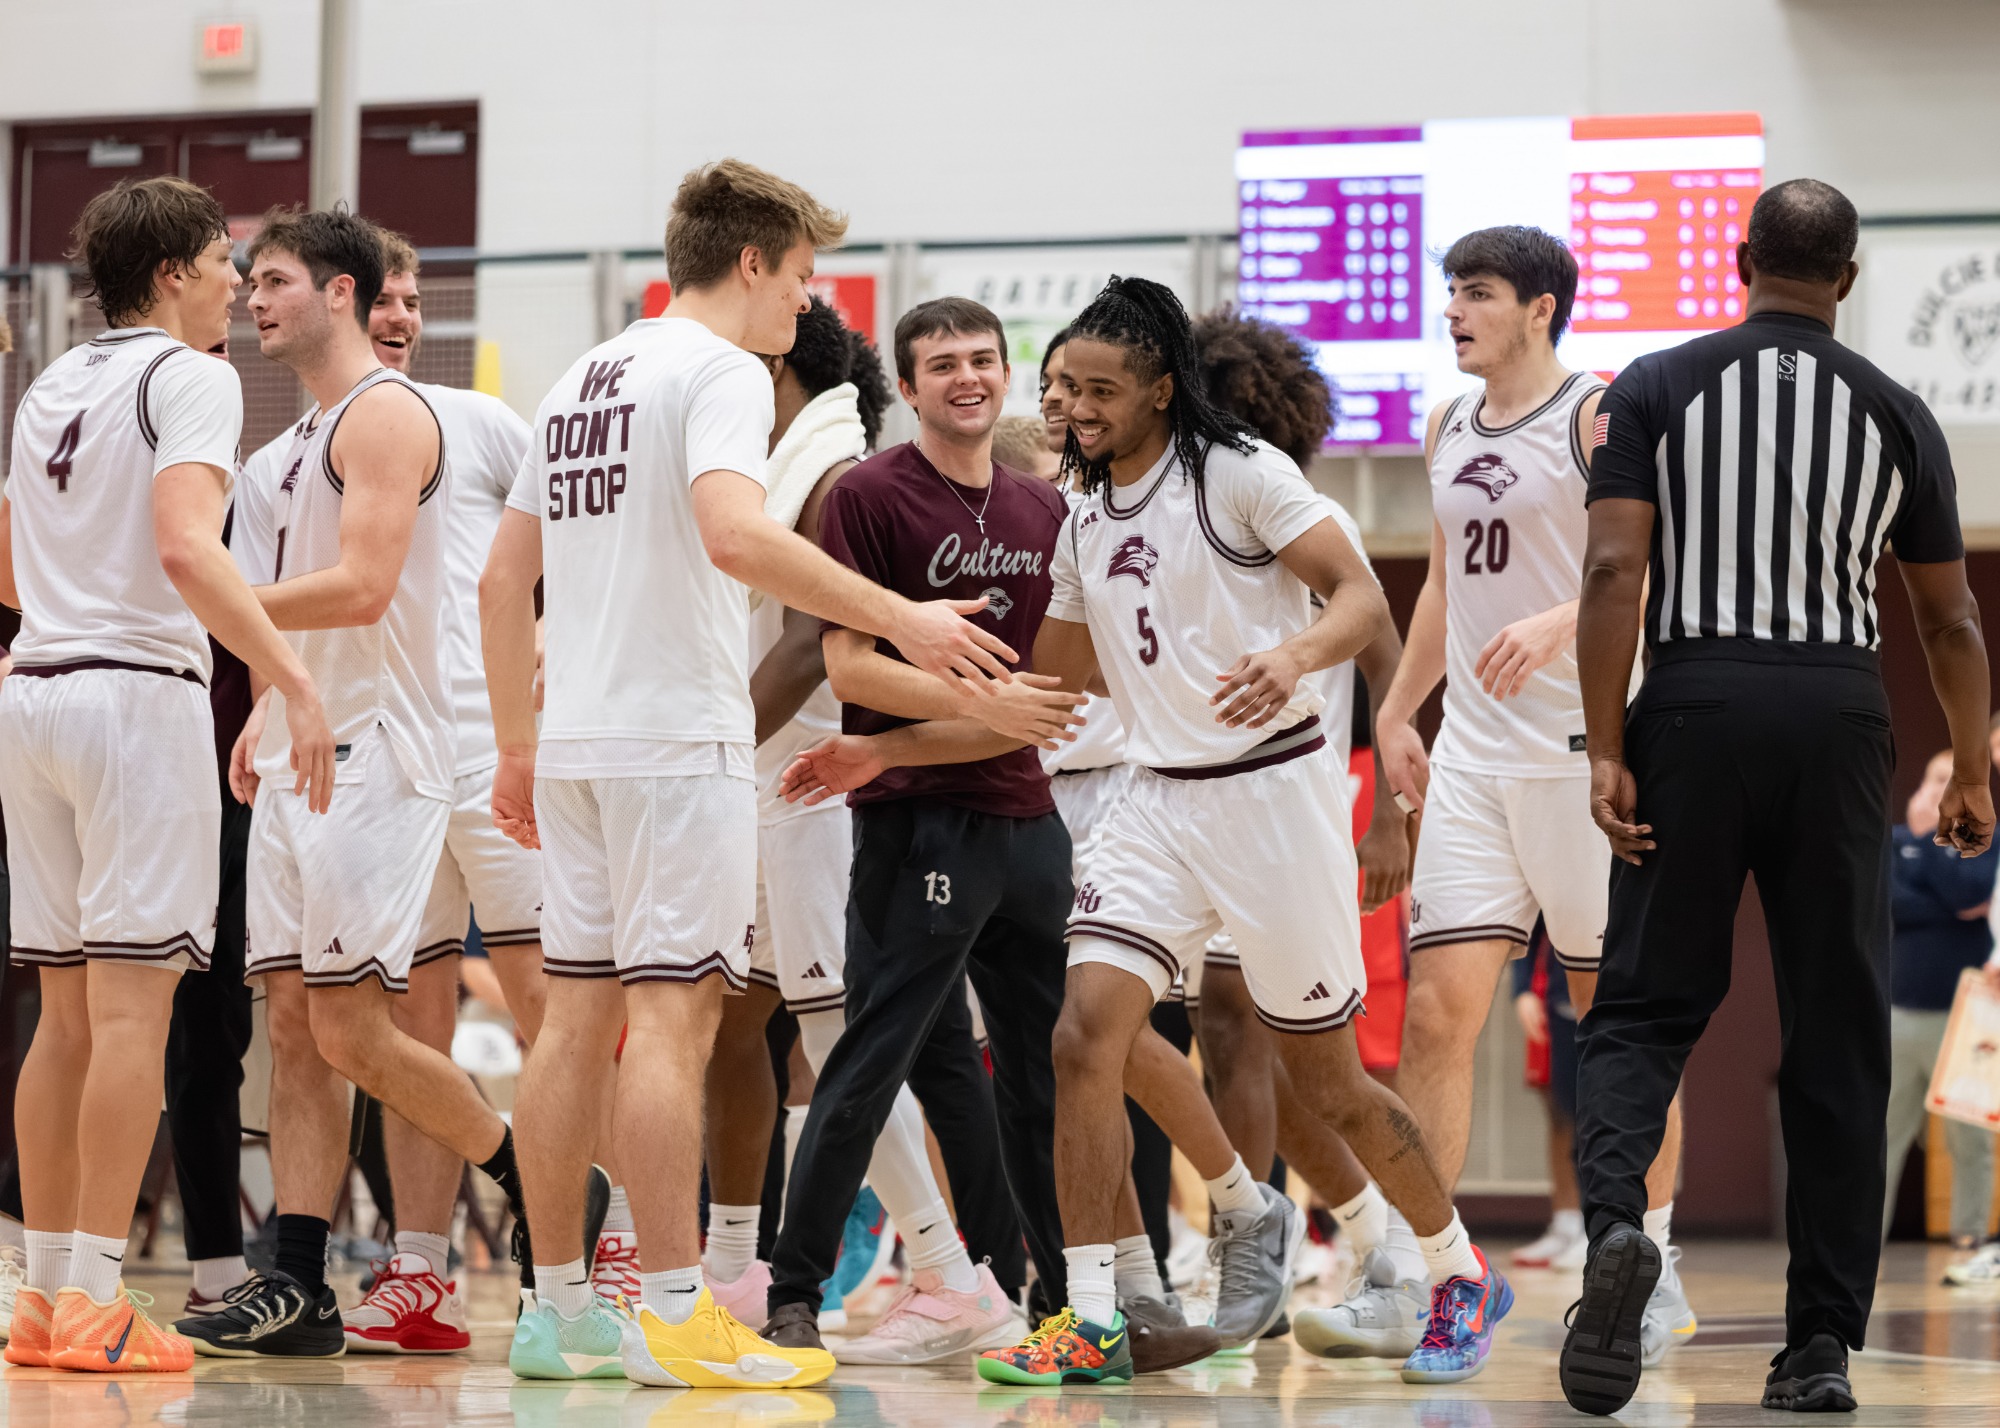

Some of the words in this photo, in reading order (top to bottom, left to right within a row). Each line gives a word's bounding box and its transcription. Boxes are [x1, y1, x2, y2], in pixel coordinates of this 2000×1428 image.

[579, 354, 635, 402] WE
[46, 407, 90, 493] 4
[546, 403, 636, 464] DON'T
[549, 463, 627, 521] STOP
[927, 533, 1043, 588] Culture
[1464, 518, 1510, 575] 20
[1136, 604, 1159, 667] 5
[924, 871, 951, 905] 13
